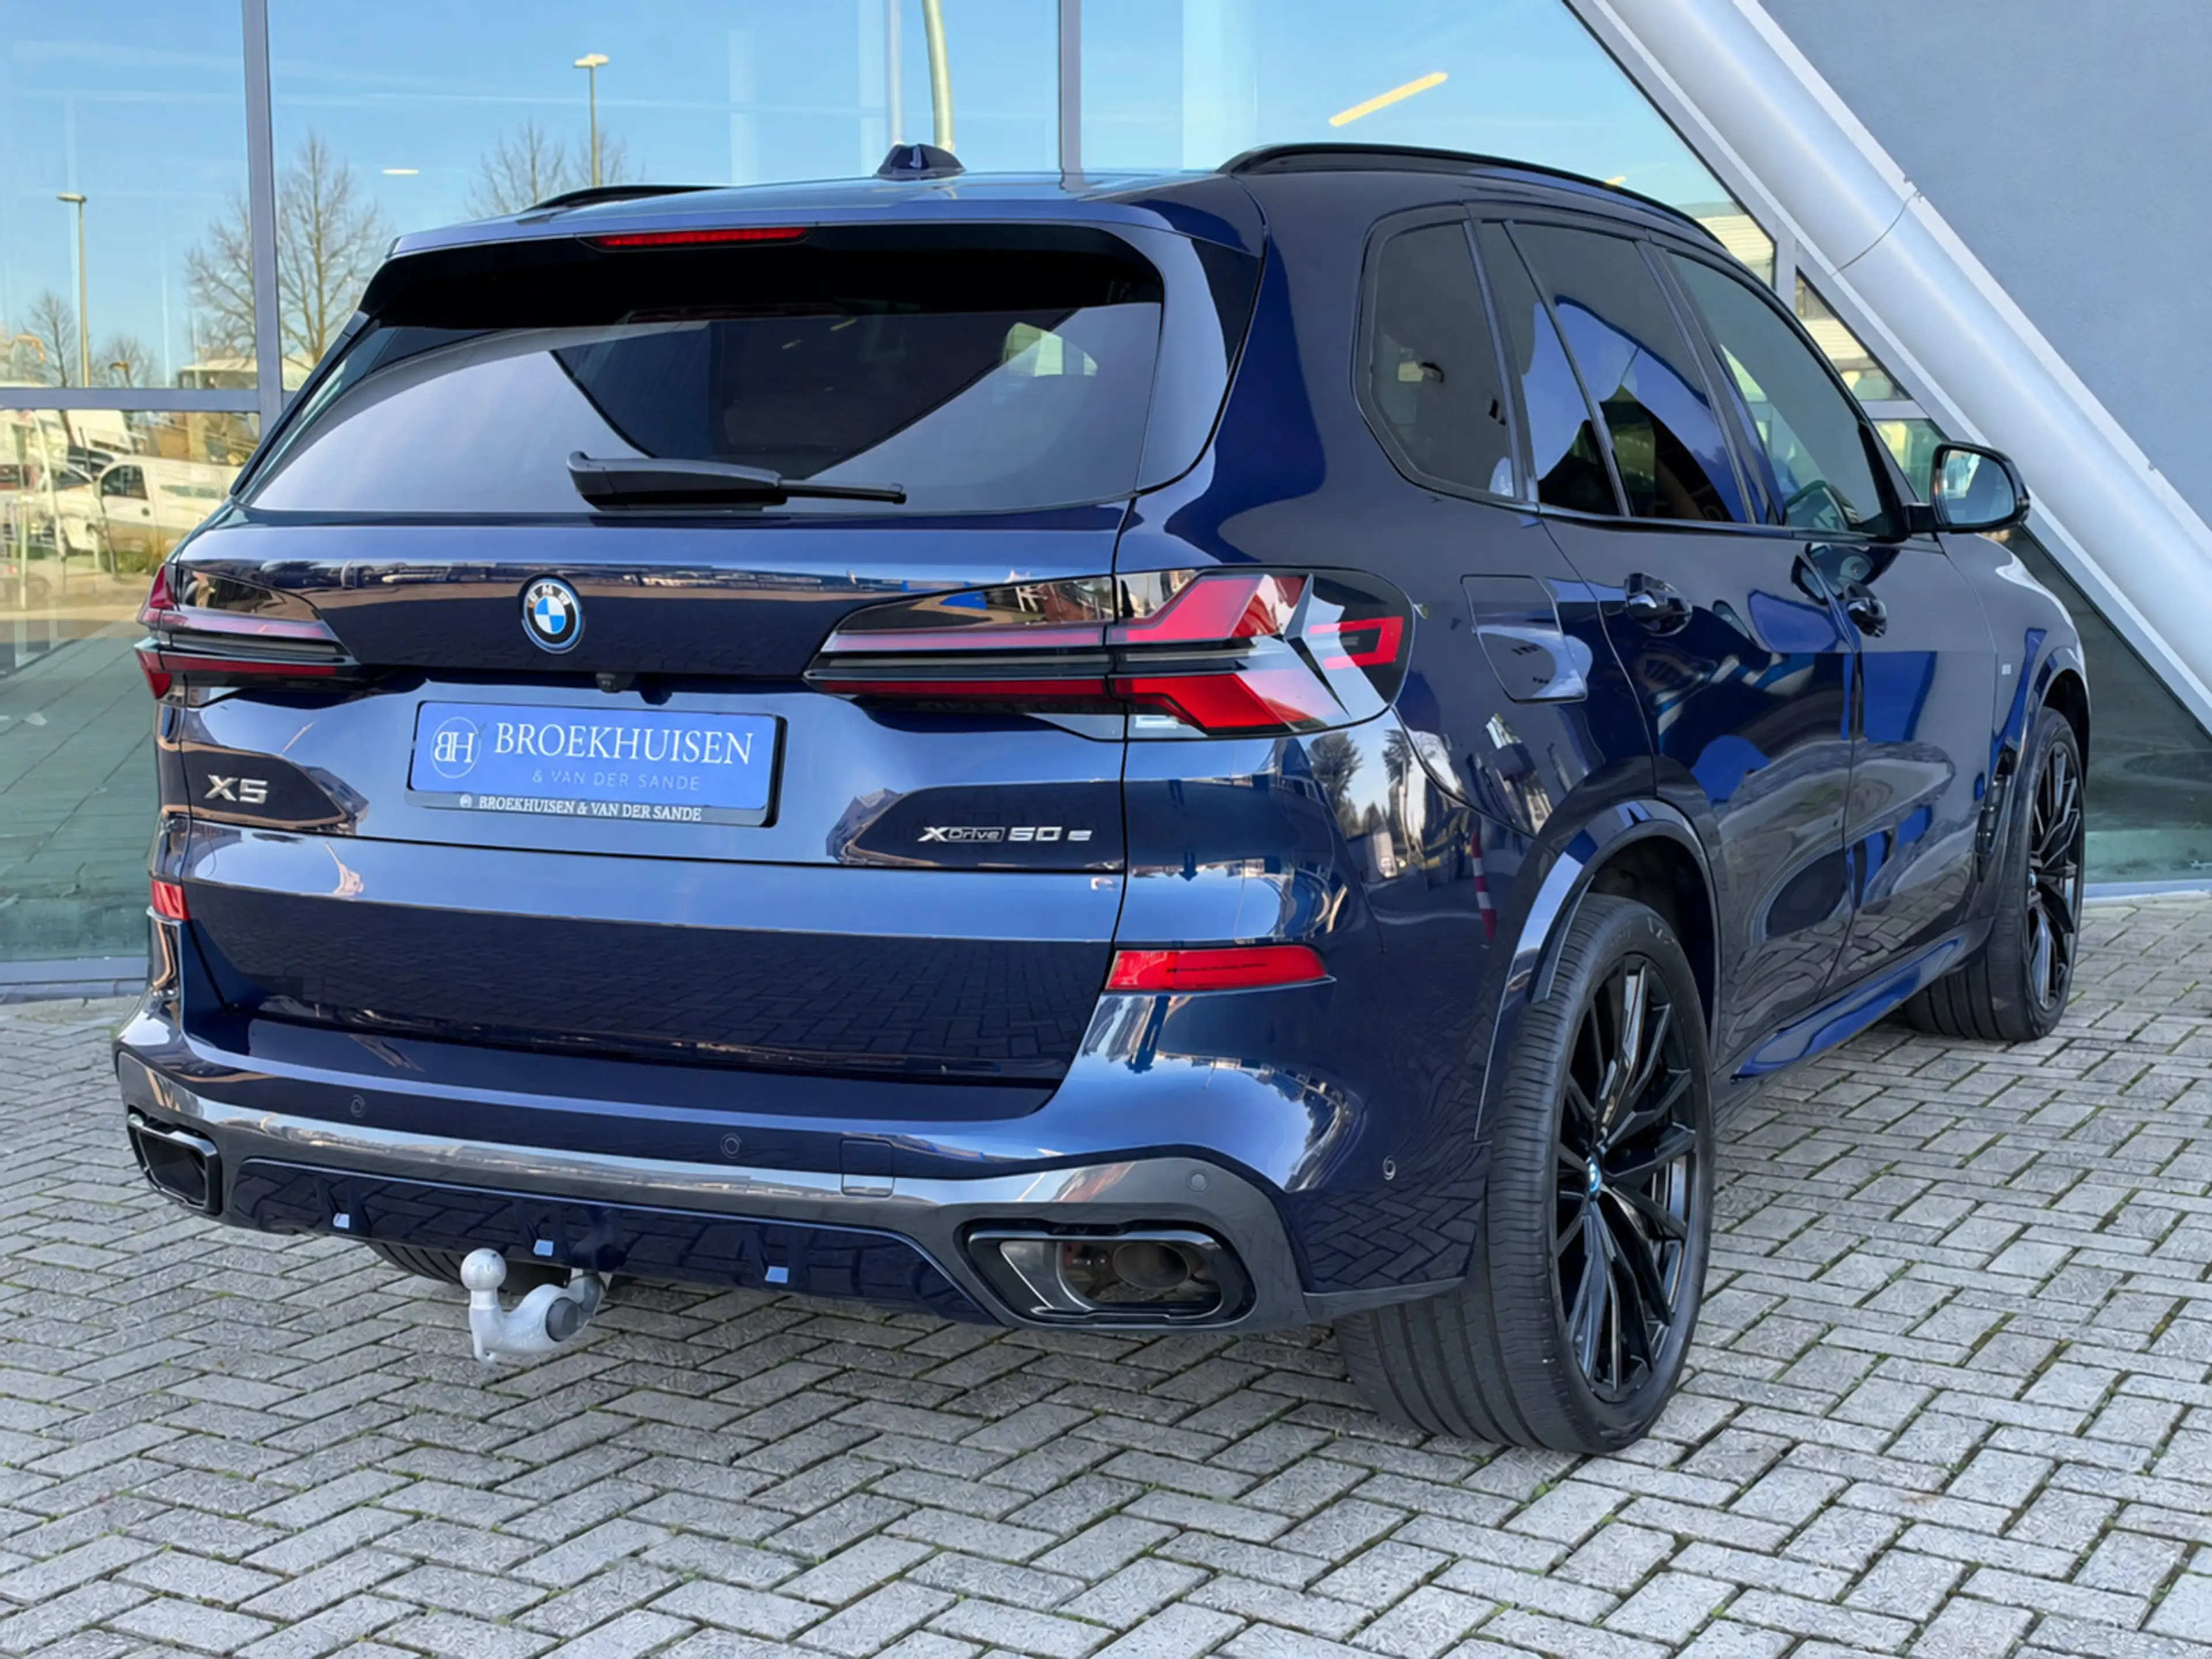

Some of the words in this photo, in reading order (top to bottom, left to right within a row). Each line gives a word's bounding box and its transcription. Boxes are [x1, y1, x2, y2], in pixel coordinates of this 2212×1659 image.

[494, 722, 753, 764] BROEKHUISEN
[204, 774, 268, 804] X5
[532, 769, 543, 783] &
[551, 770, 585, 785] VAN
[593, 772, 628, 787] DER
[638, 774, 700, 791] SANDE
[479, 795, 576, 814] BROEKHUISEN
[577, 804, 588, 815] &
[590, 803, 620, 817] VAN
[622, 806, 650, 819] DER
[652, 806, 702, 821] SANDE
[1008, 827, 1062, 841] 50
